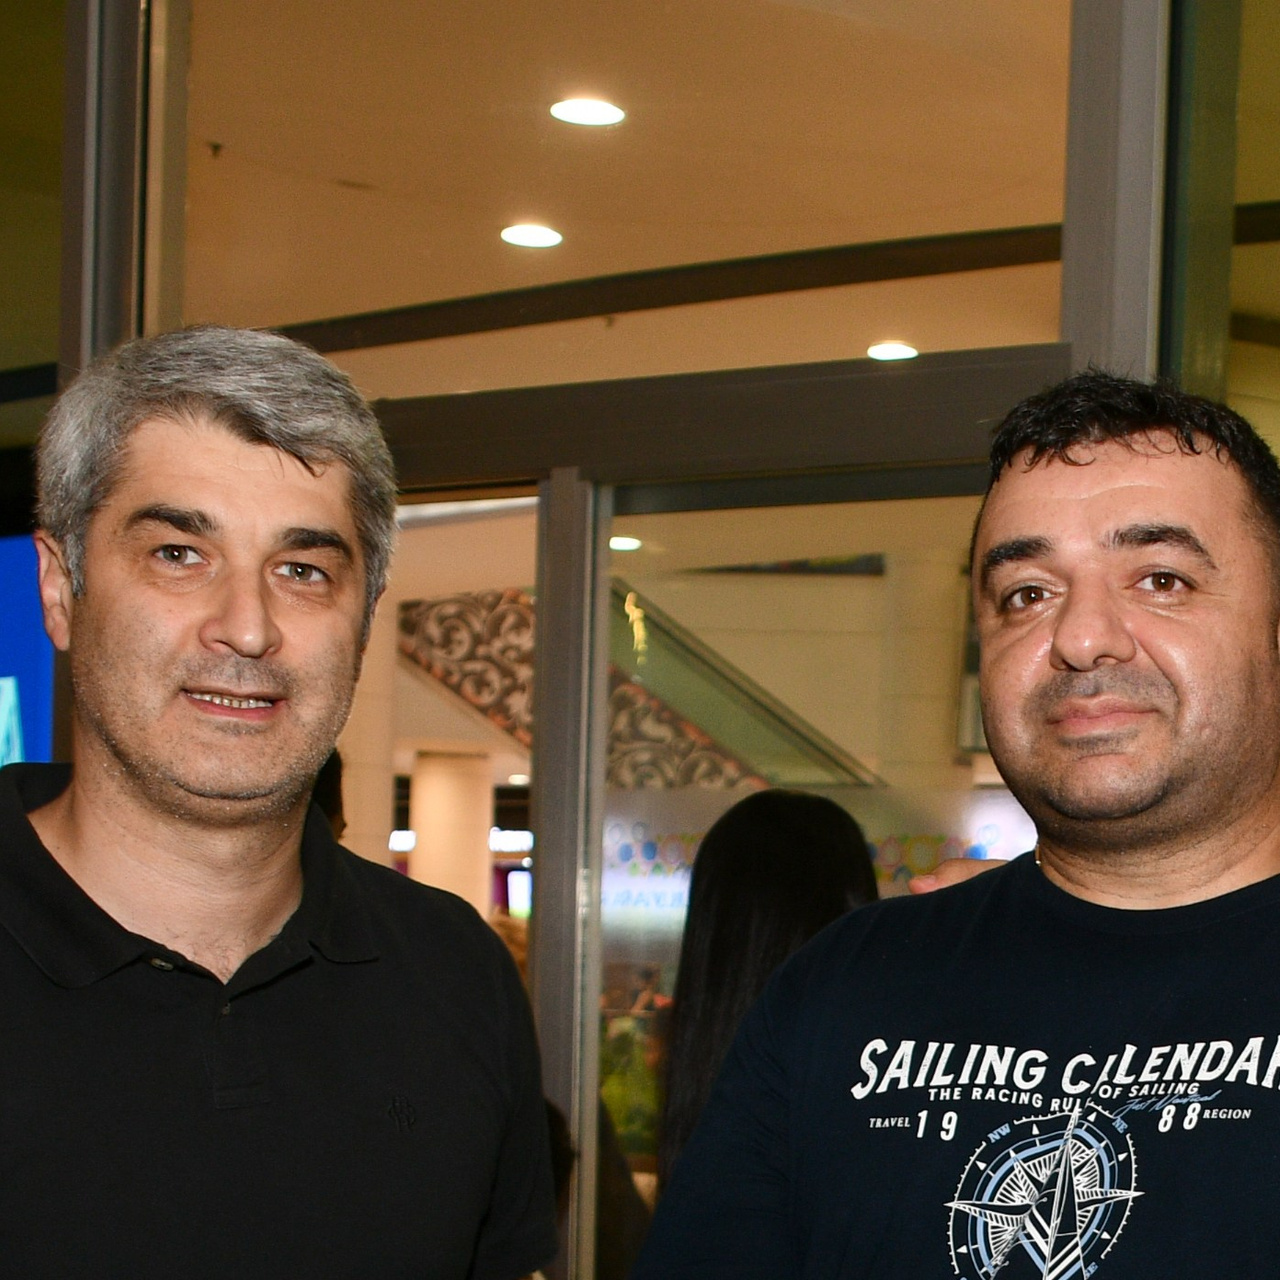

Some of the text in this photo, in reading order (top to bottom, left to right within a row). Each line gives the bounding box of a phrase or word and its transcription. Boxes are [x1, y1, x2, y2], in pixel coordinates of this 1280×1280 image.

[850, 1038, 1049, 1100] SAILING
[928, 1087, 962, 1101] THE
[971, 1087, 1043, 1108] RACING
[1098, 1084, 1123, 1099] OF
[1128, 1082, 1200, 1097] SAILING
[869, 1116, 911, 1128] TRAVEL
[1202, 1109, 1252, 1119] REGION
[1112, 1116, 1128, 1134] NE
[987, 1122, 1011, 1143] NW
